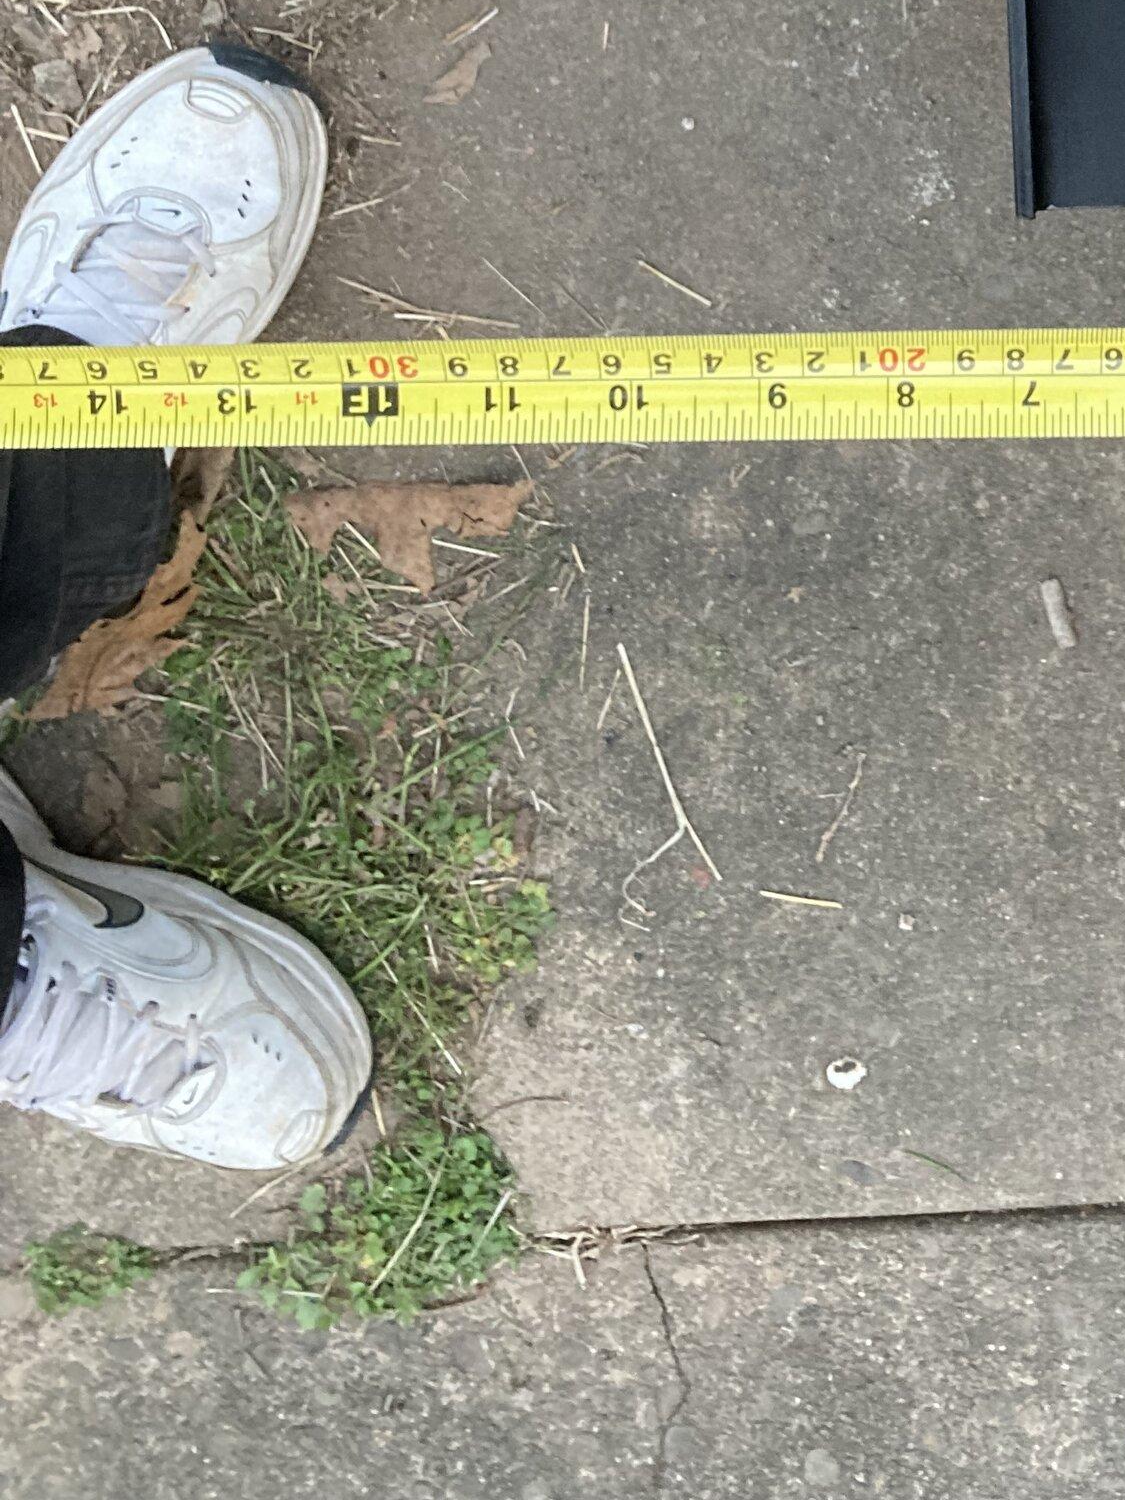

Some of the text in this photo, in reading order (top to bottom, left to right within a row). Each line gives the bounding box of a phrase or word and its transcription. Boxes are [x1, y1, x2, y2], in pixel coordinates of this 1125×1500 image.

[189, 360, 208, 379] 4
[241, 359, 261, 379] 3
[293, 359, 312, 378] 2
[347, 359, 361, 377] 1
[448, 357, 468, 376] 9
[499, 356, 519, 377] 8
[552, 356, 571, 376] 7
[602, 355, 621, 375] 6
[653, 354, 672, 374] 5
[704, 354, 723, 373] 4
[755, 352, 774, 373] 3
[807, 351, 825, 372] 2
[859, 351, 872, 372] 1
[957, 349, 975, 371] 9
[1006, 349, 1025, 370] 8
[1055, 349, 1074, 369] 7
[1105, 348, 1123, 370] 6
[38, 362, 58, 380] 7
[87, 360, 107, 380] 6
[138, 361, 158, 379] 5
[88, 389, 128, 415] 14
[217, 388, 257, 414] 13
[349, 386, 392, 412] 1F
[485, 387, 521, 411] 11
[609, 385, 649, 410] 10
[768, 383, 787, 409] 9
[897, 381, 915, 407] 8
[1022, 381, 1040, 406] 7
